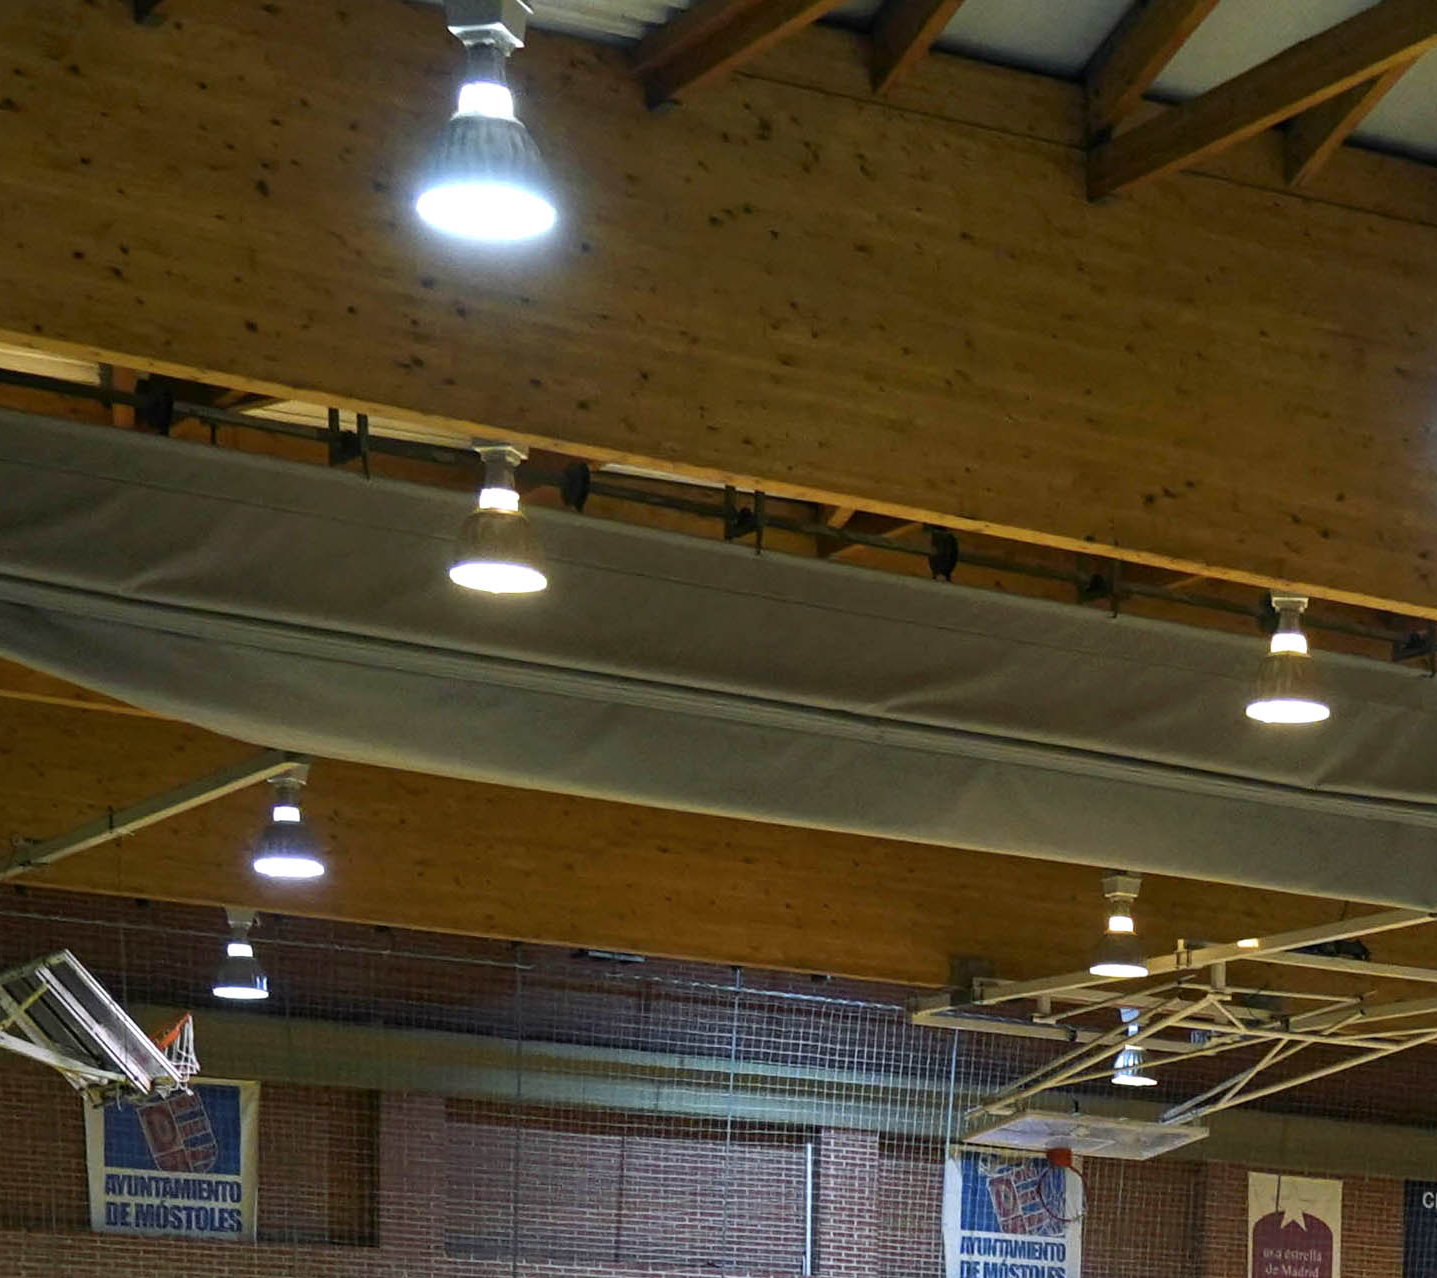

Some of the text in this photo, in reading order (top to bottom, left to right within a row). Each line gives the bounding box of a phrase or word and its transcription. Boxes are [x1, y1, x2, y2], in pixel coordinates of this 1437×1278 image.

[105, 1174, 242, 1203] AYUNTAMIENTO
[105, 1200, 242, 1233] DE MÓSTOLES
[960, 1236, 1066, 1262] AYUNTAMIENTO
[1265, 1264, 1319, 1278] de Madrid
